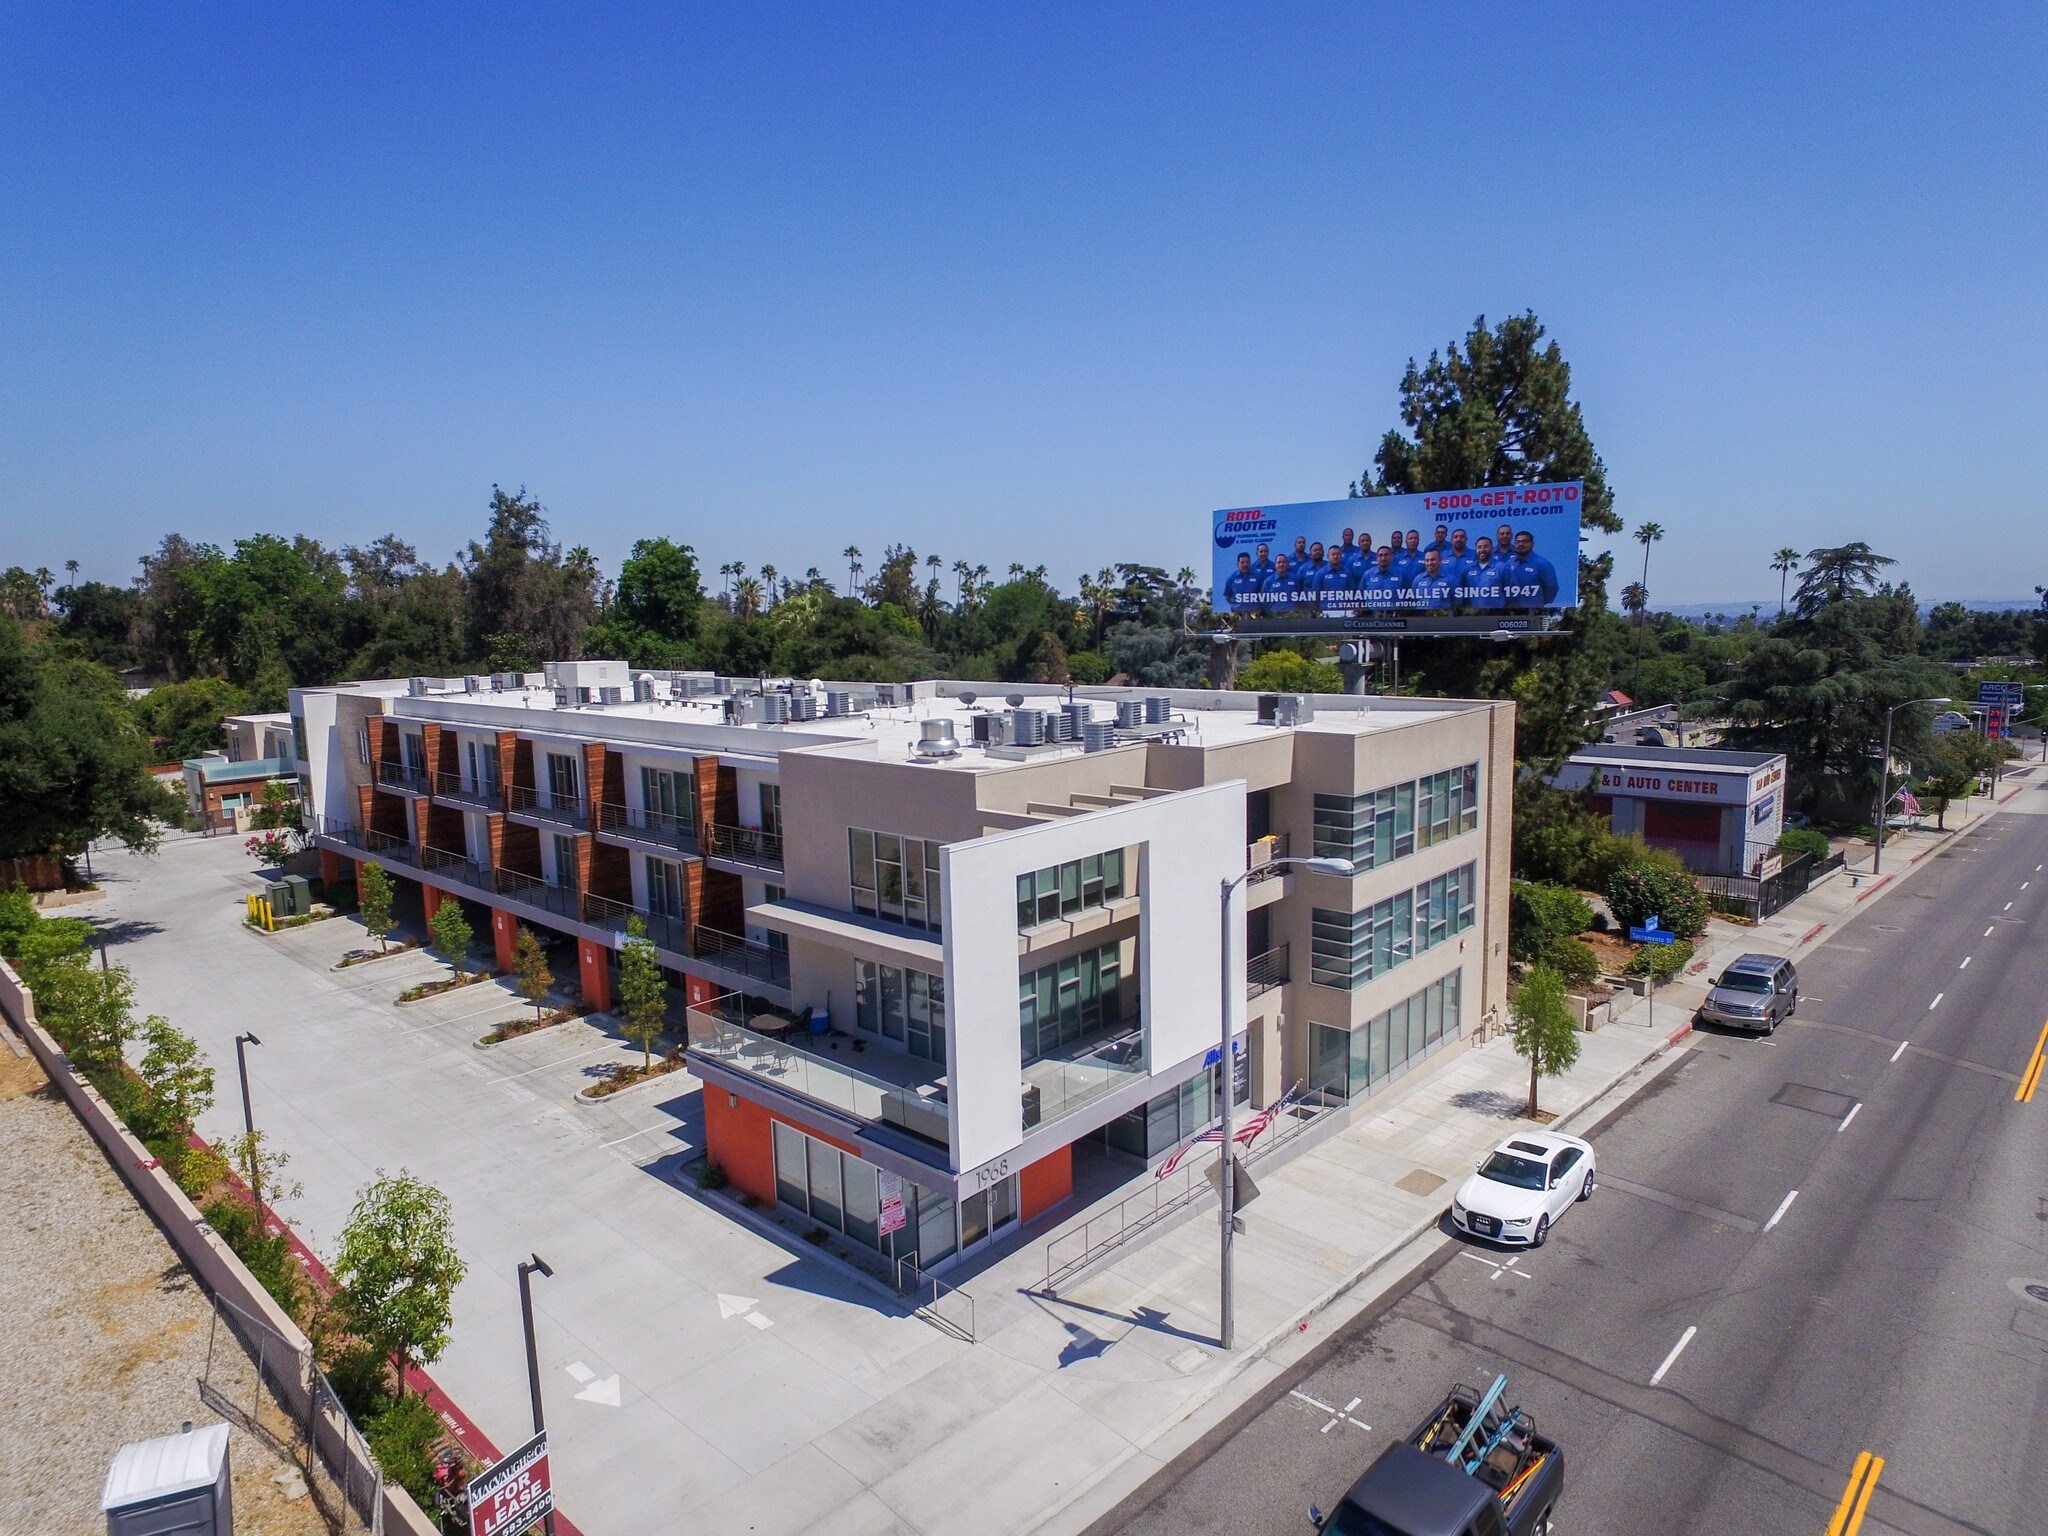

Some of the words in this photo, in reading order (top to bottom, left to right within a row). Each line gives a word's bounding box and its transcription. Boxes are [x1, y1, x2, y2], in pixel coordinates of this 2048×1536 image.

[1423, 486, 1579, 510] 1-800-GET-ROTO
[1226, 510, 1266, 521] ROTO-
[1435, 505, 1563, 522] myrotorooter.com
[1224, 519, 1277, 532] ROOTER
[1235, 592, 1288, 603] SERVING
[1291, 591, 1317, 602] SAN
[1320, 589, 1393, 601] FERNANDO
[1396, 588, 1450, 599] VALLEY
[1454, 586, 1500, 598] SINCE
[1503, 585, 1540, 598] 1947
[1499, 620, 1528, 628] 006028
[1627, 776, 1661, 790] AUTO
[1667, 779, 1718, 795] CENTER
[976, 1159, 1008, 1189] 1968
[494, 1471, 531, 1510] FOR
[484, 1479, 542, 1535] LEASE
